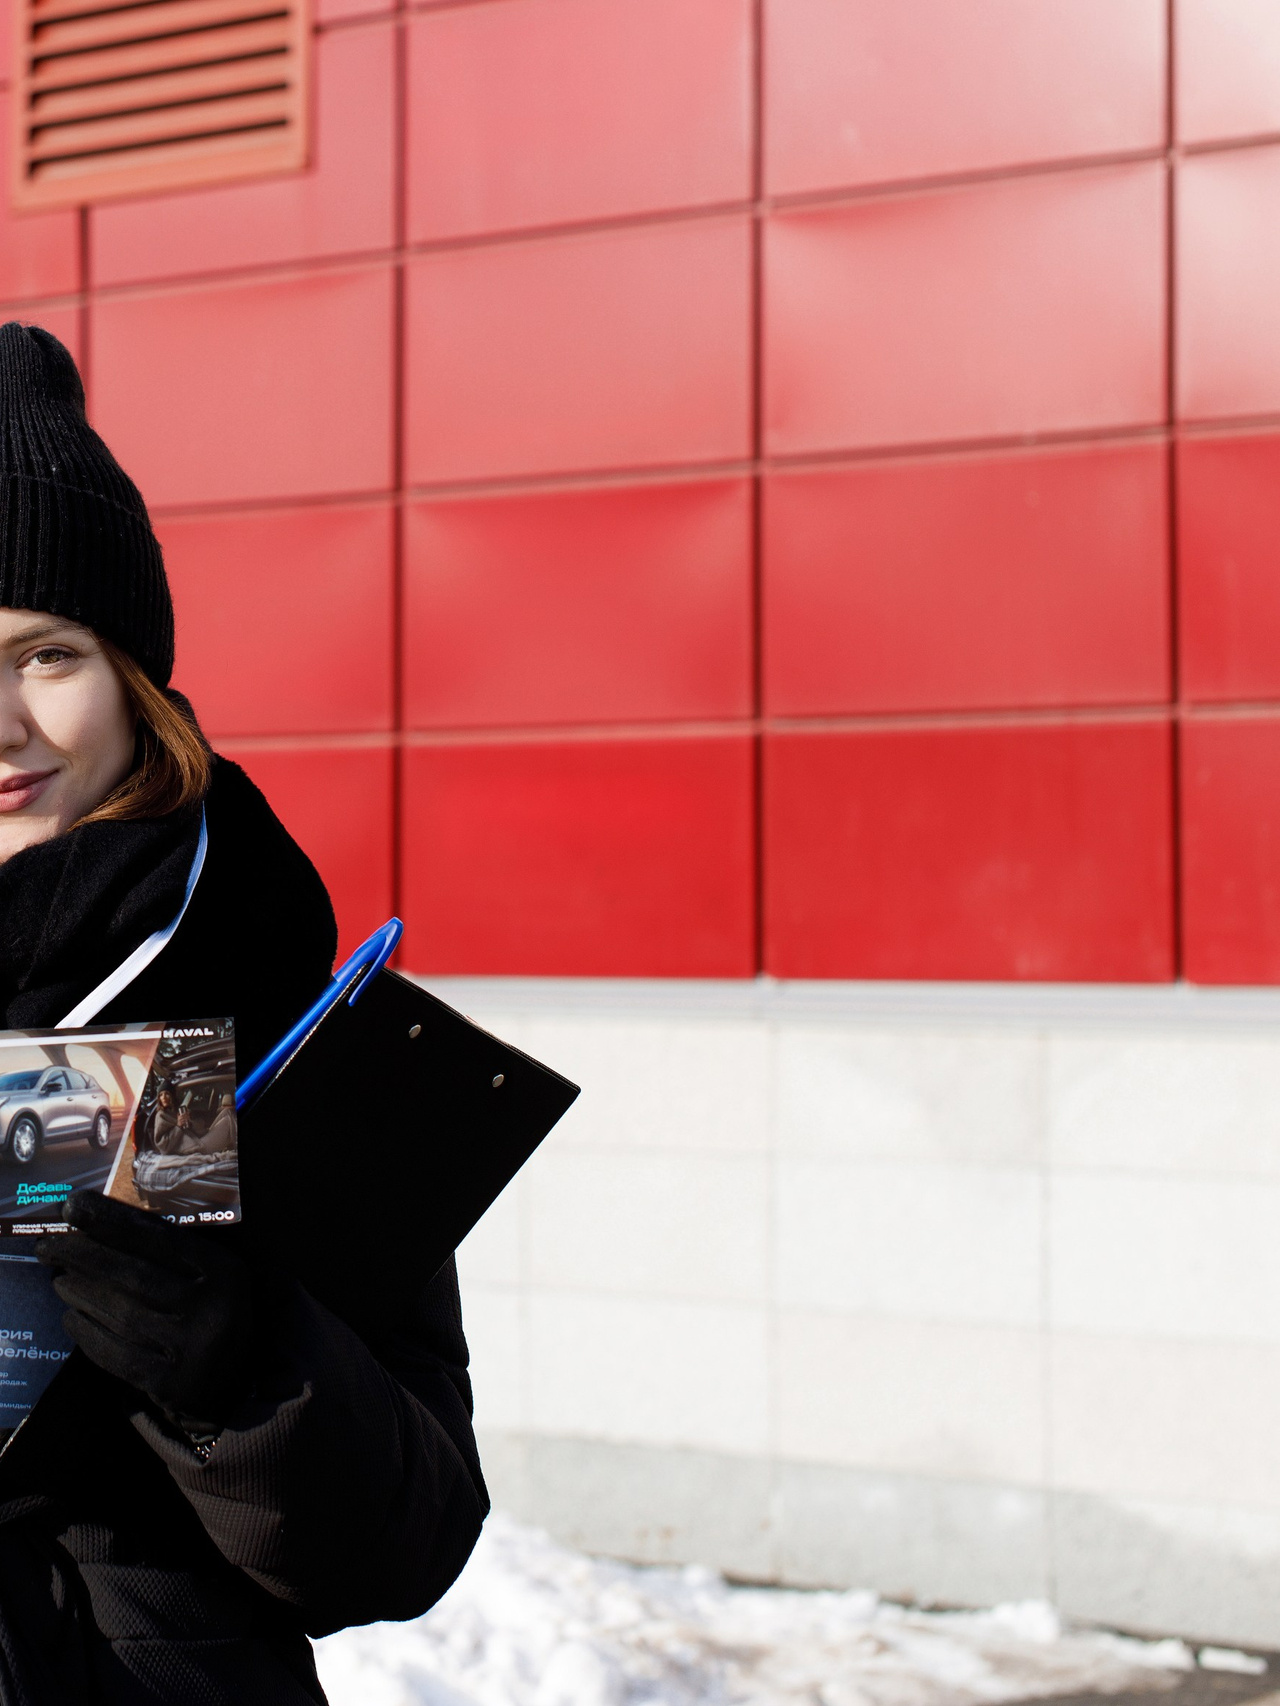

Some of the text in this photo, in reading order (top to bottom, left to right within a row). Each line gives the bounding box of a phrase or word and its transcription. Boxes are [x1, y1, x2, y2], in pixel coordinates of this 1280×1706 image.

[163, 1027, 214, 1038] HAVAL
[16, 1182, 73, 1195] Добавь
[179, 1215, 195, 1224] до
[198, 1210, 235, 1221] 15:00
